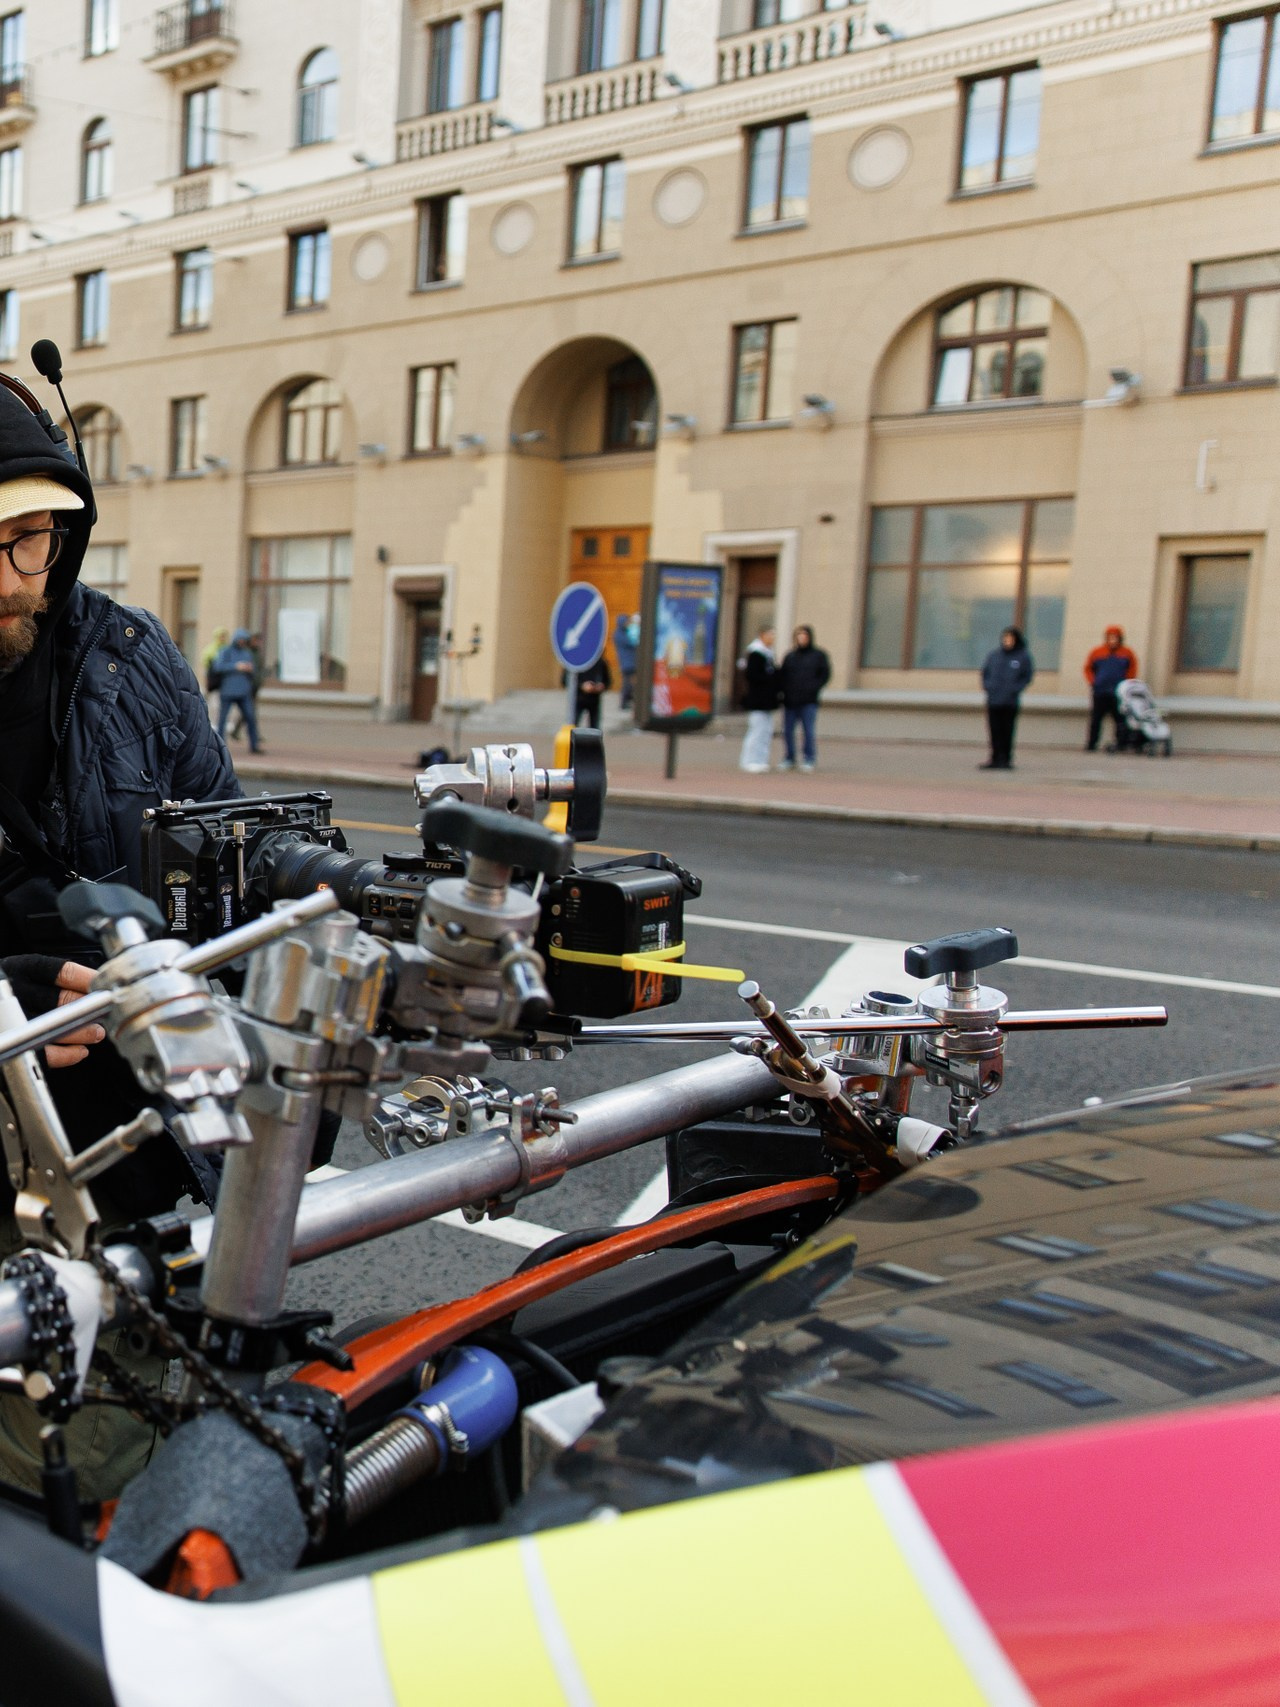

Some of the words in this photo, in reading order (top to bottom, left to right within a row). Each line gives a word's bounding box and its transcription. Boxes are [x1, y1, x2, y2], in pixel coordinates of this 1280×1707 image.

[319, 829, 337, 837] TILTA
[425, 861, 452, 870] TILTA
[643, 896, 670, 910] SWIT
